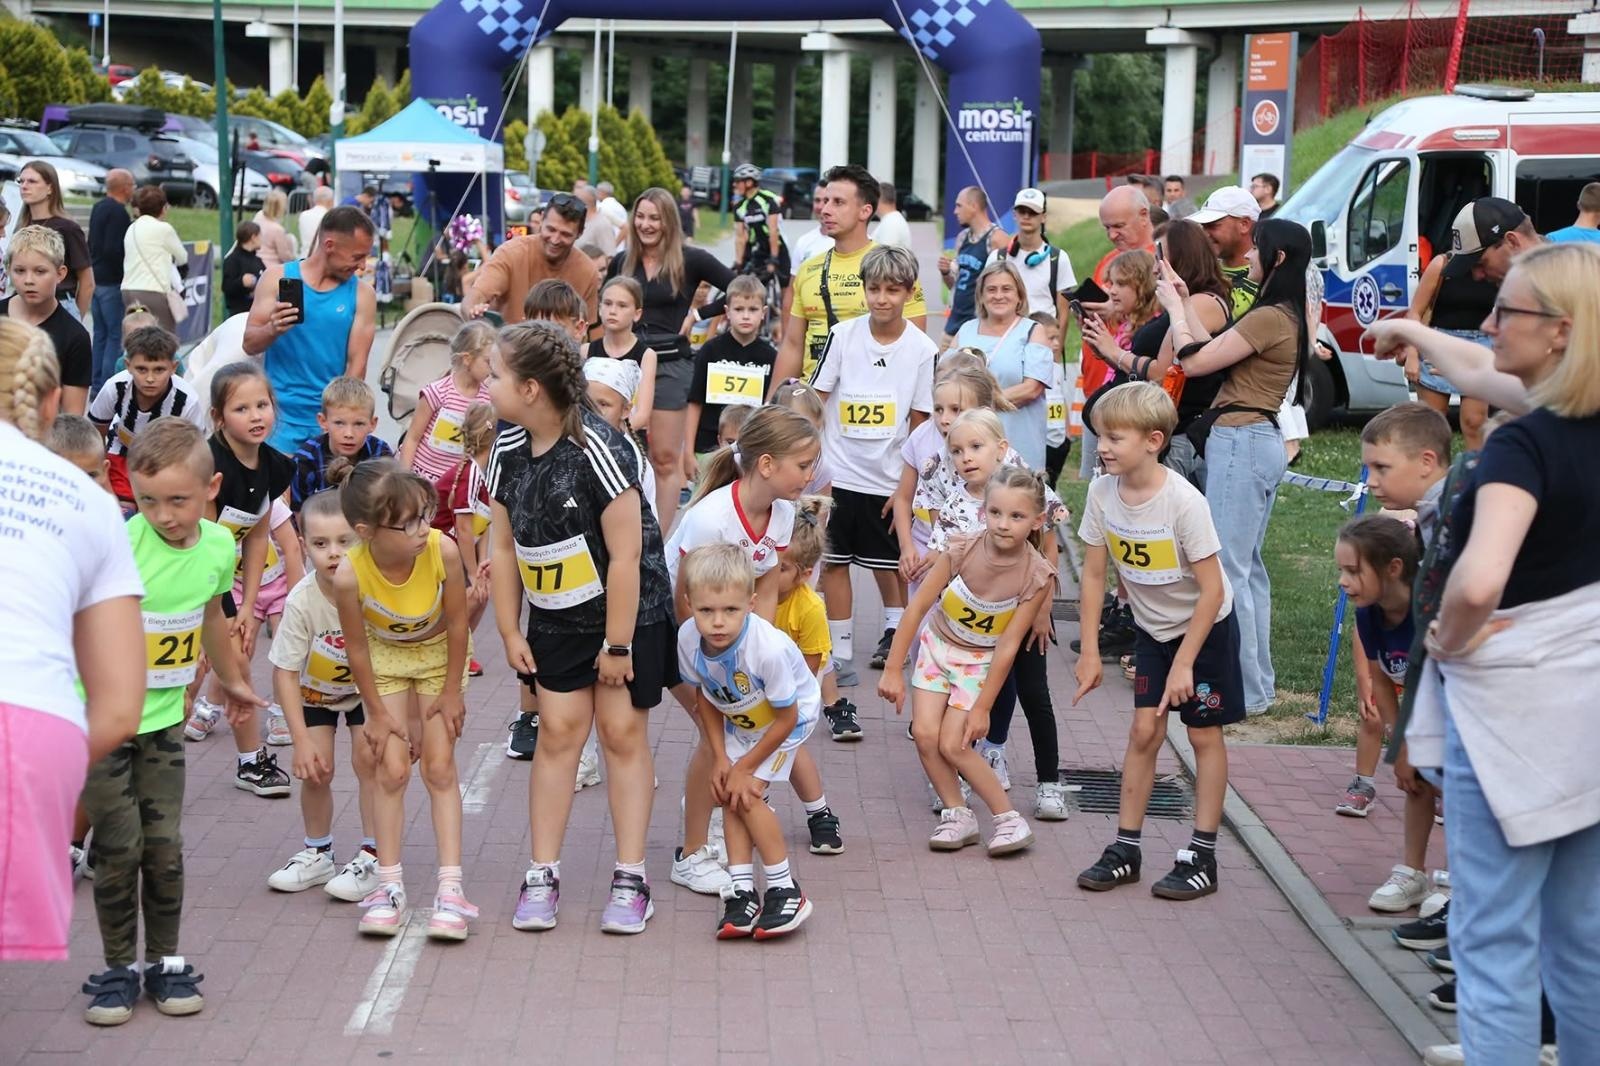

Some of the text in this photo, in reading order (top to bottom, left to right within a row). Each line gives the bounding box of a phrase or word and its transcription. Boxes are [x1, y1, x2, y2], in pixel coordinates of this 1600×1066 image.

[436, 104, 489, 127] osir
[958, 108, 1032, 130] mosir
[965, 130, 1024, 143] centrum
[723, 375, 749, 393] 57
[846, 404, 886, 425] 125
[1048, 404, 1063, 419] 19
[2, 474, 86, 512] ekreacji
[551, 541, 577, 554] Gwiazd
[1119, 540, 1152, 568] 25
[527, 562, 564, 591] 77
[388, 617, 431, 633] 65
[958, 607, 995, 633] 24
[153, 631, 195, 666] 21
[331, 665, 352, 683] 2
[731, 714, 756, 730] 3
